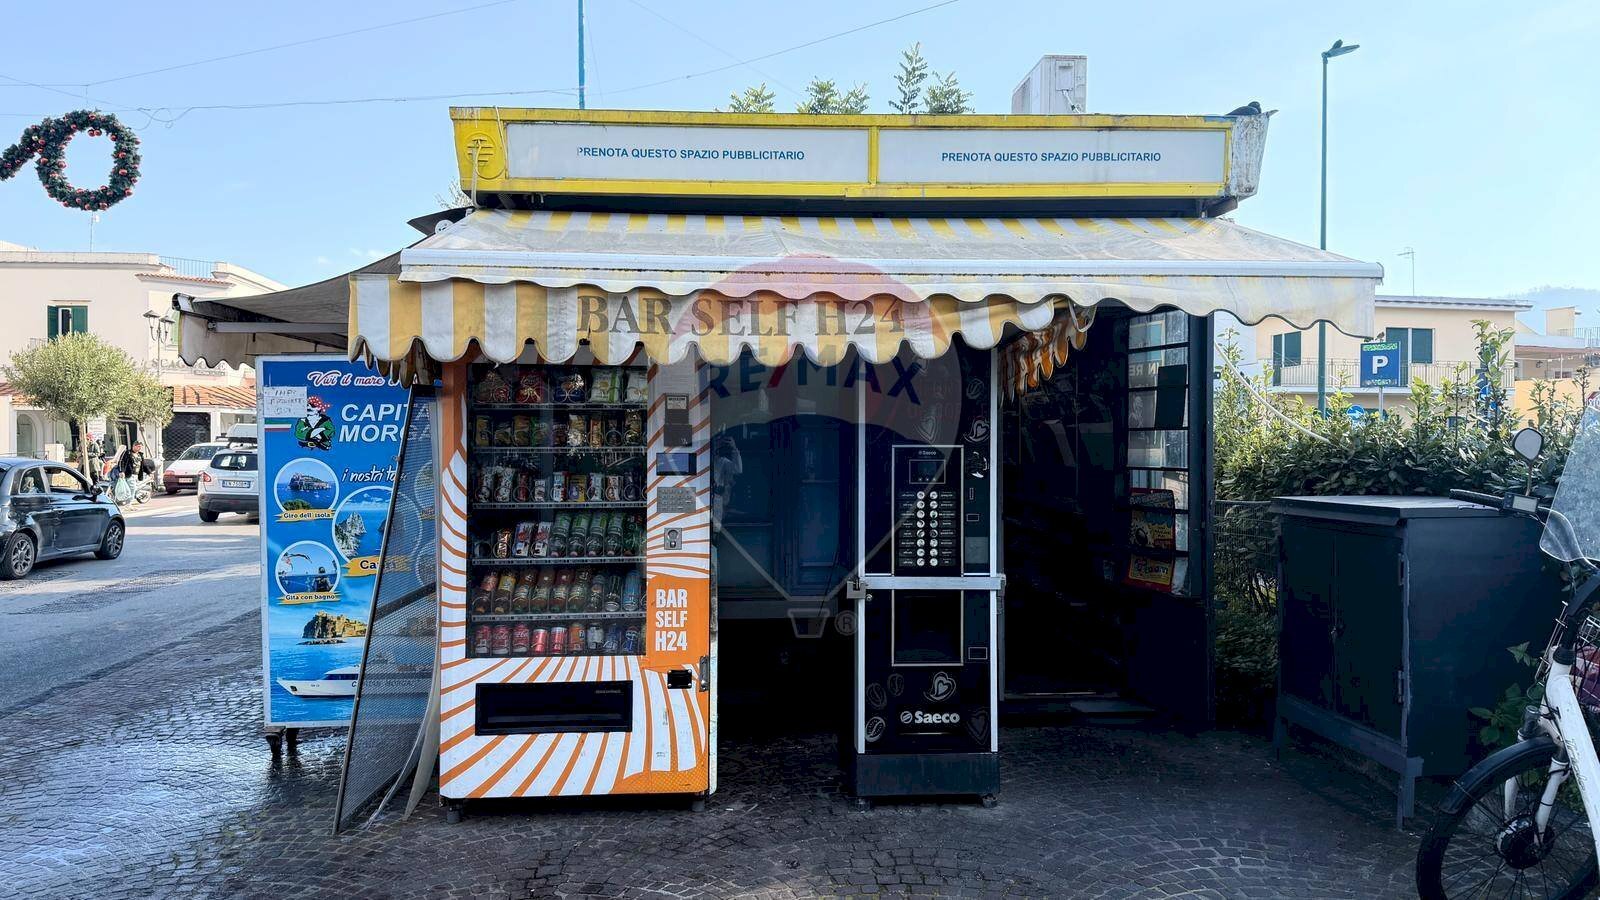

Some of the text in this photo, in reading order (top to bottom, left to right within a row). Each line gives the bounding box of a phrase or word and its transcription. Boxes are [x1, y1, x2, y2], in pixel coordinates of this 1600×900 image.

[577, 147, 804, 160] PRENOTA QUESTO SPAZIO PUBBLICITARIO
[942, 152, 1161, 163] PRENOTA QUESTO SPAZIO PUBBLICITARIO
[577, 295, 905, 336] BAR SELF H24
[1372, 355, 1388, 374] P
[307, 370, 341, 387] Vivi
[340, 373, 353, 386] il
[354, 376, 385, 386] mare
[348, 465, 385, 482] nostri
[315, 593, 335, 601] bagno
[655, 588, 688, 609] BAR
[655, 610, 688, 628] SELF
[655, 630, 688, 652] H24
[914, 711, 960, 724] Saeco
